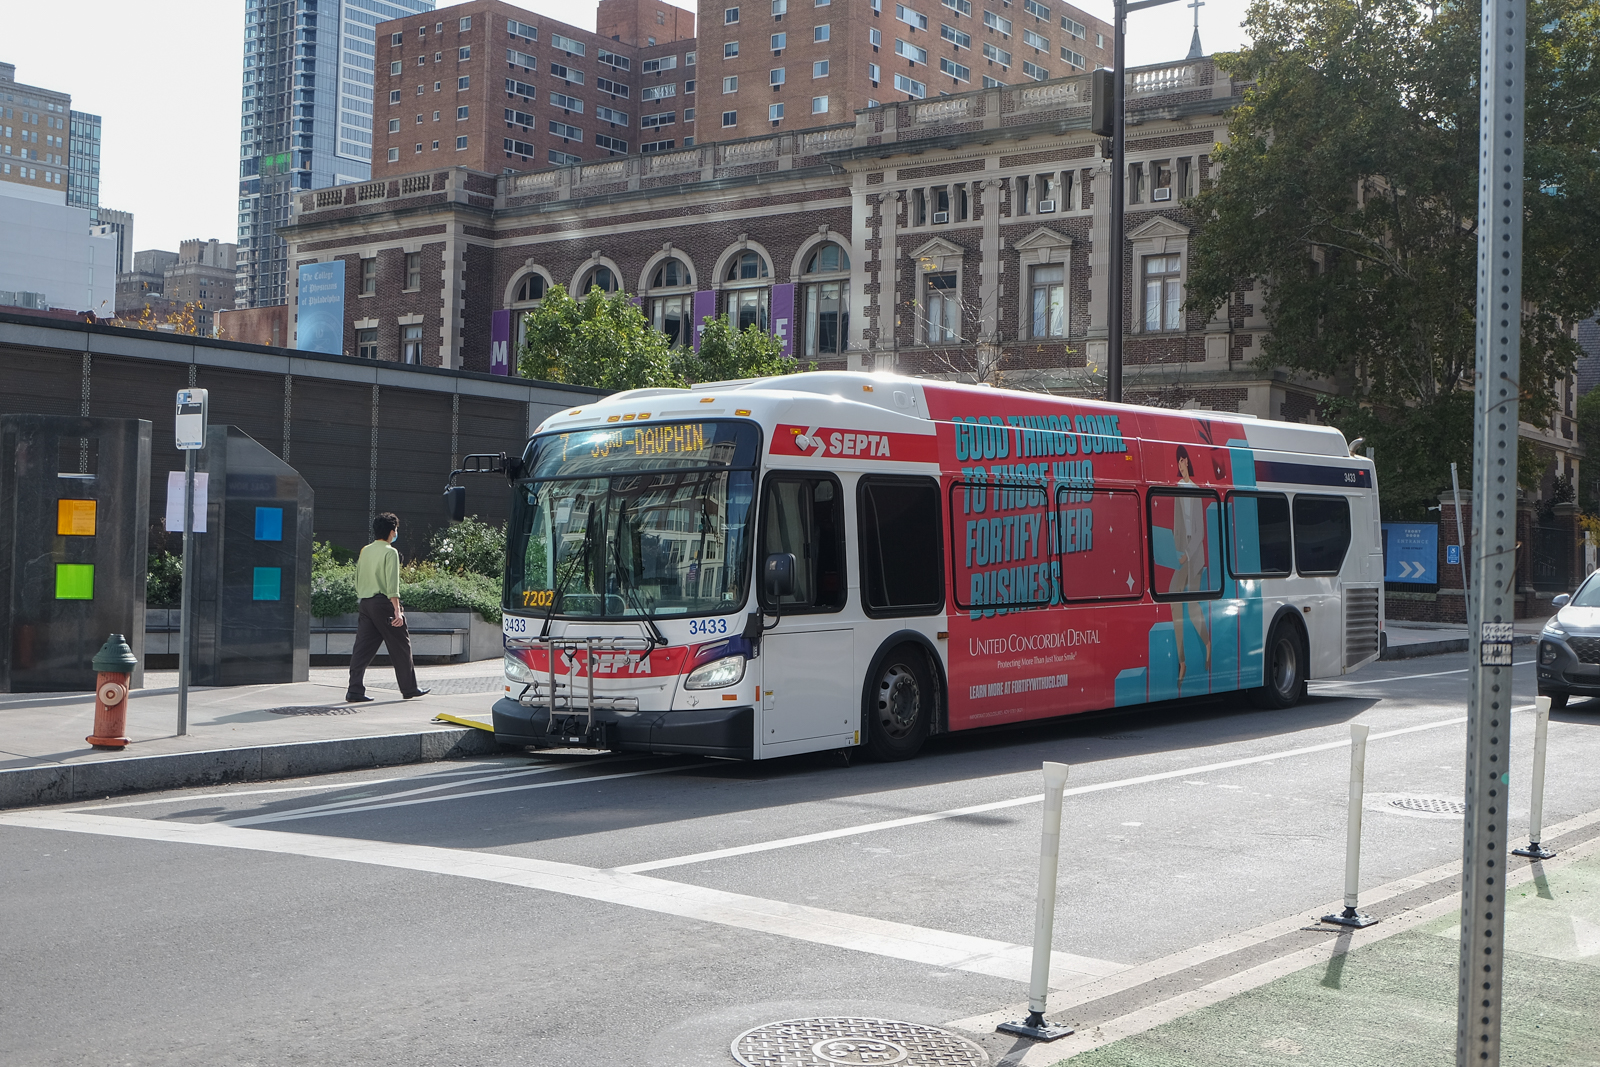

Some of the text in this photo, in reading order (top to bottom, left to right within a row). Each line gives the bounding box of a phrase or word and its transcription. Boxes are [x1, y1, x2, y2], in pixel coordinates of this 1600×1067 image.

[302, 271, 334, 281] The College
[302, 282, 338, 293] of Physicians
[301, 295, 341, 306] of Philadelphia
[491, 341, 508, 367] M
[177, 404, 183, 415] 7
[829, 431, 891, 457] SEPTA
[952, 414, 1128, 461] GOOD THINGS COME
[559, 433, 570, 461] 7
[1343, 472, 1356, 483] 3433
[961, 459, 1095, 514] TO THOSE WHO
[965, 507, 1093, 568] FORTIFY THEIR
[522, 590, 554, 607] 7202
[969, 560, 1061, 620] BUSINESS
[504, 618, 526, 633] 3433
[689, 618, 728, 635] 3433
[969, 628, 1101, 656] UNITED CONCORDIA DENTAL
[1482, 643, 1512, 655] BUTTER
[997, 659, 1021, 669] Protecting
[1033, 656, 1044, 664] Than
[1045, 655, 1054, 664] Just
[1053, 654, 1063, 662] Your
[969, 684, 987, 699] LEARN
[987, 682, 1004, 697] MORE
[1004, 681, 1011, 694] AT
